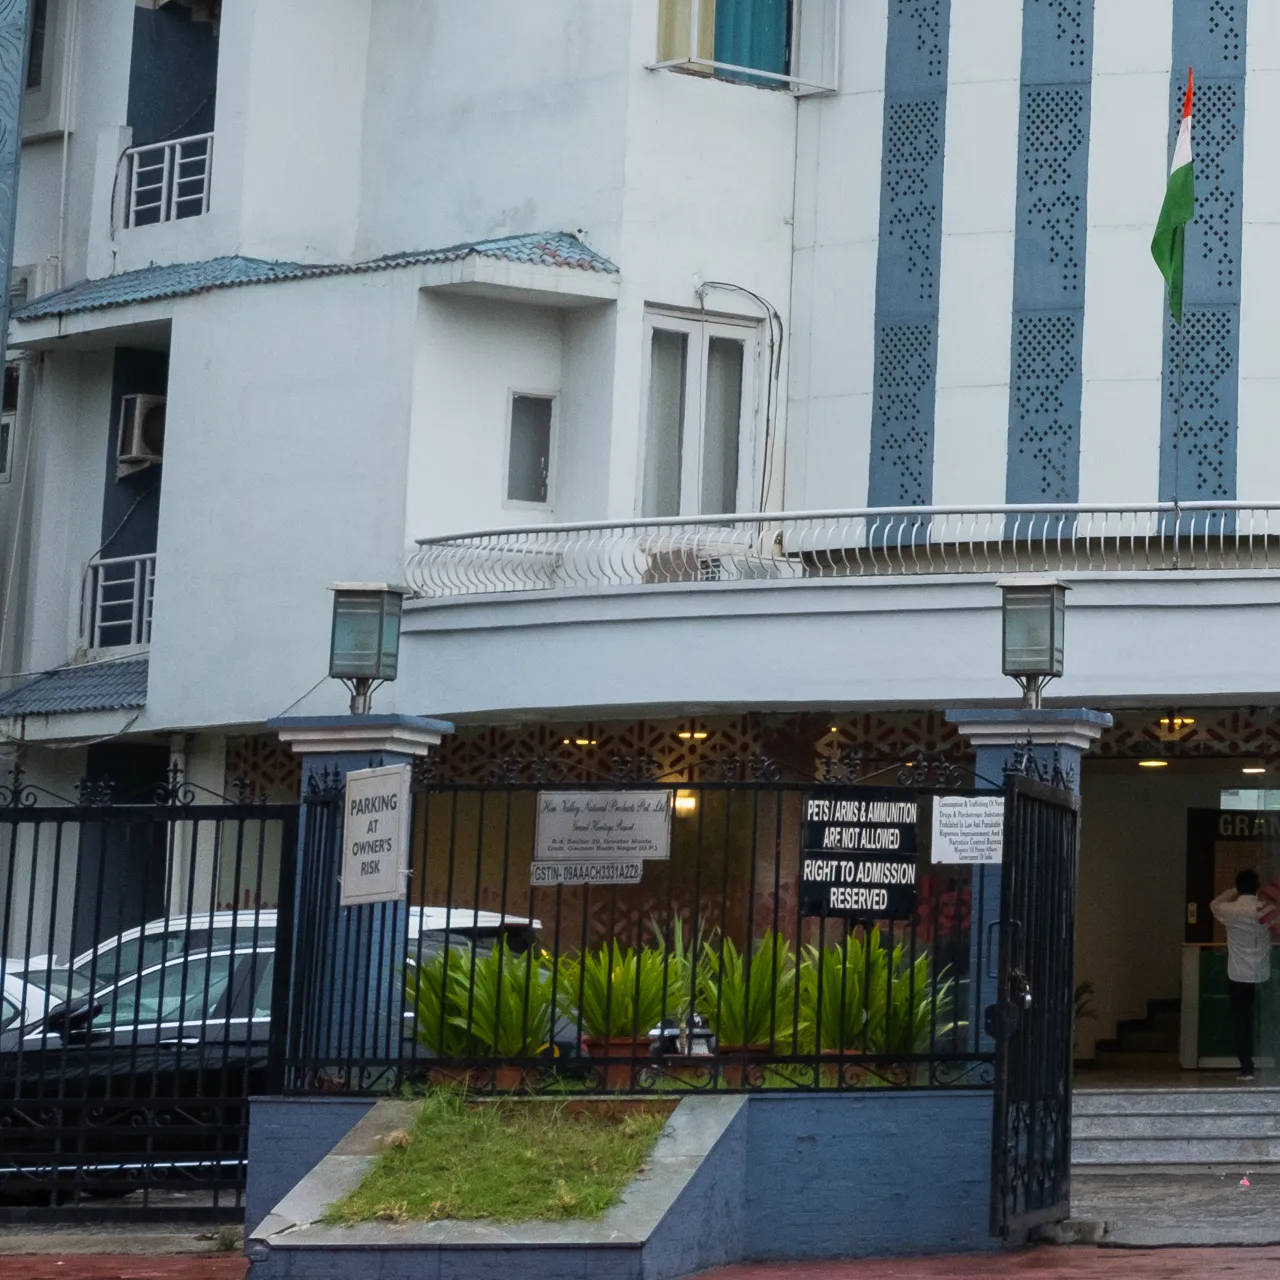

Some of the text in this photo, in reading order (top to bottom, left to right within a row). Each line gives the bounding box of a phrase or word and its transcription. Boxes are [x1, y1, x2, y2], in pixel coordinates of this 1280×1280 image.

[350, 793, 398, 817] PARKING
[807, 800, 829, 821] PETS
[834, 800, 859, 822] ARMS
[860, 801, 866, 822] &
[867, 801, 917, 823] AMMUNITION
[366, 819, 379, 835] AT
[823, 827, 900, 849] ARE NOT ALLOWED
[352, 837, 392, 856] OWNER'S
[360, 860, 380, 876] RISK
[803, 859, 916, 884] RIGHT TO ADMISSION
[830, 887, 888, 910] RESERVED
